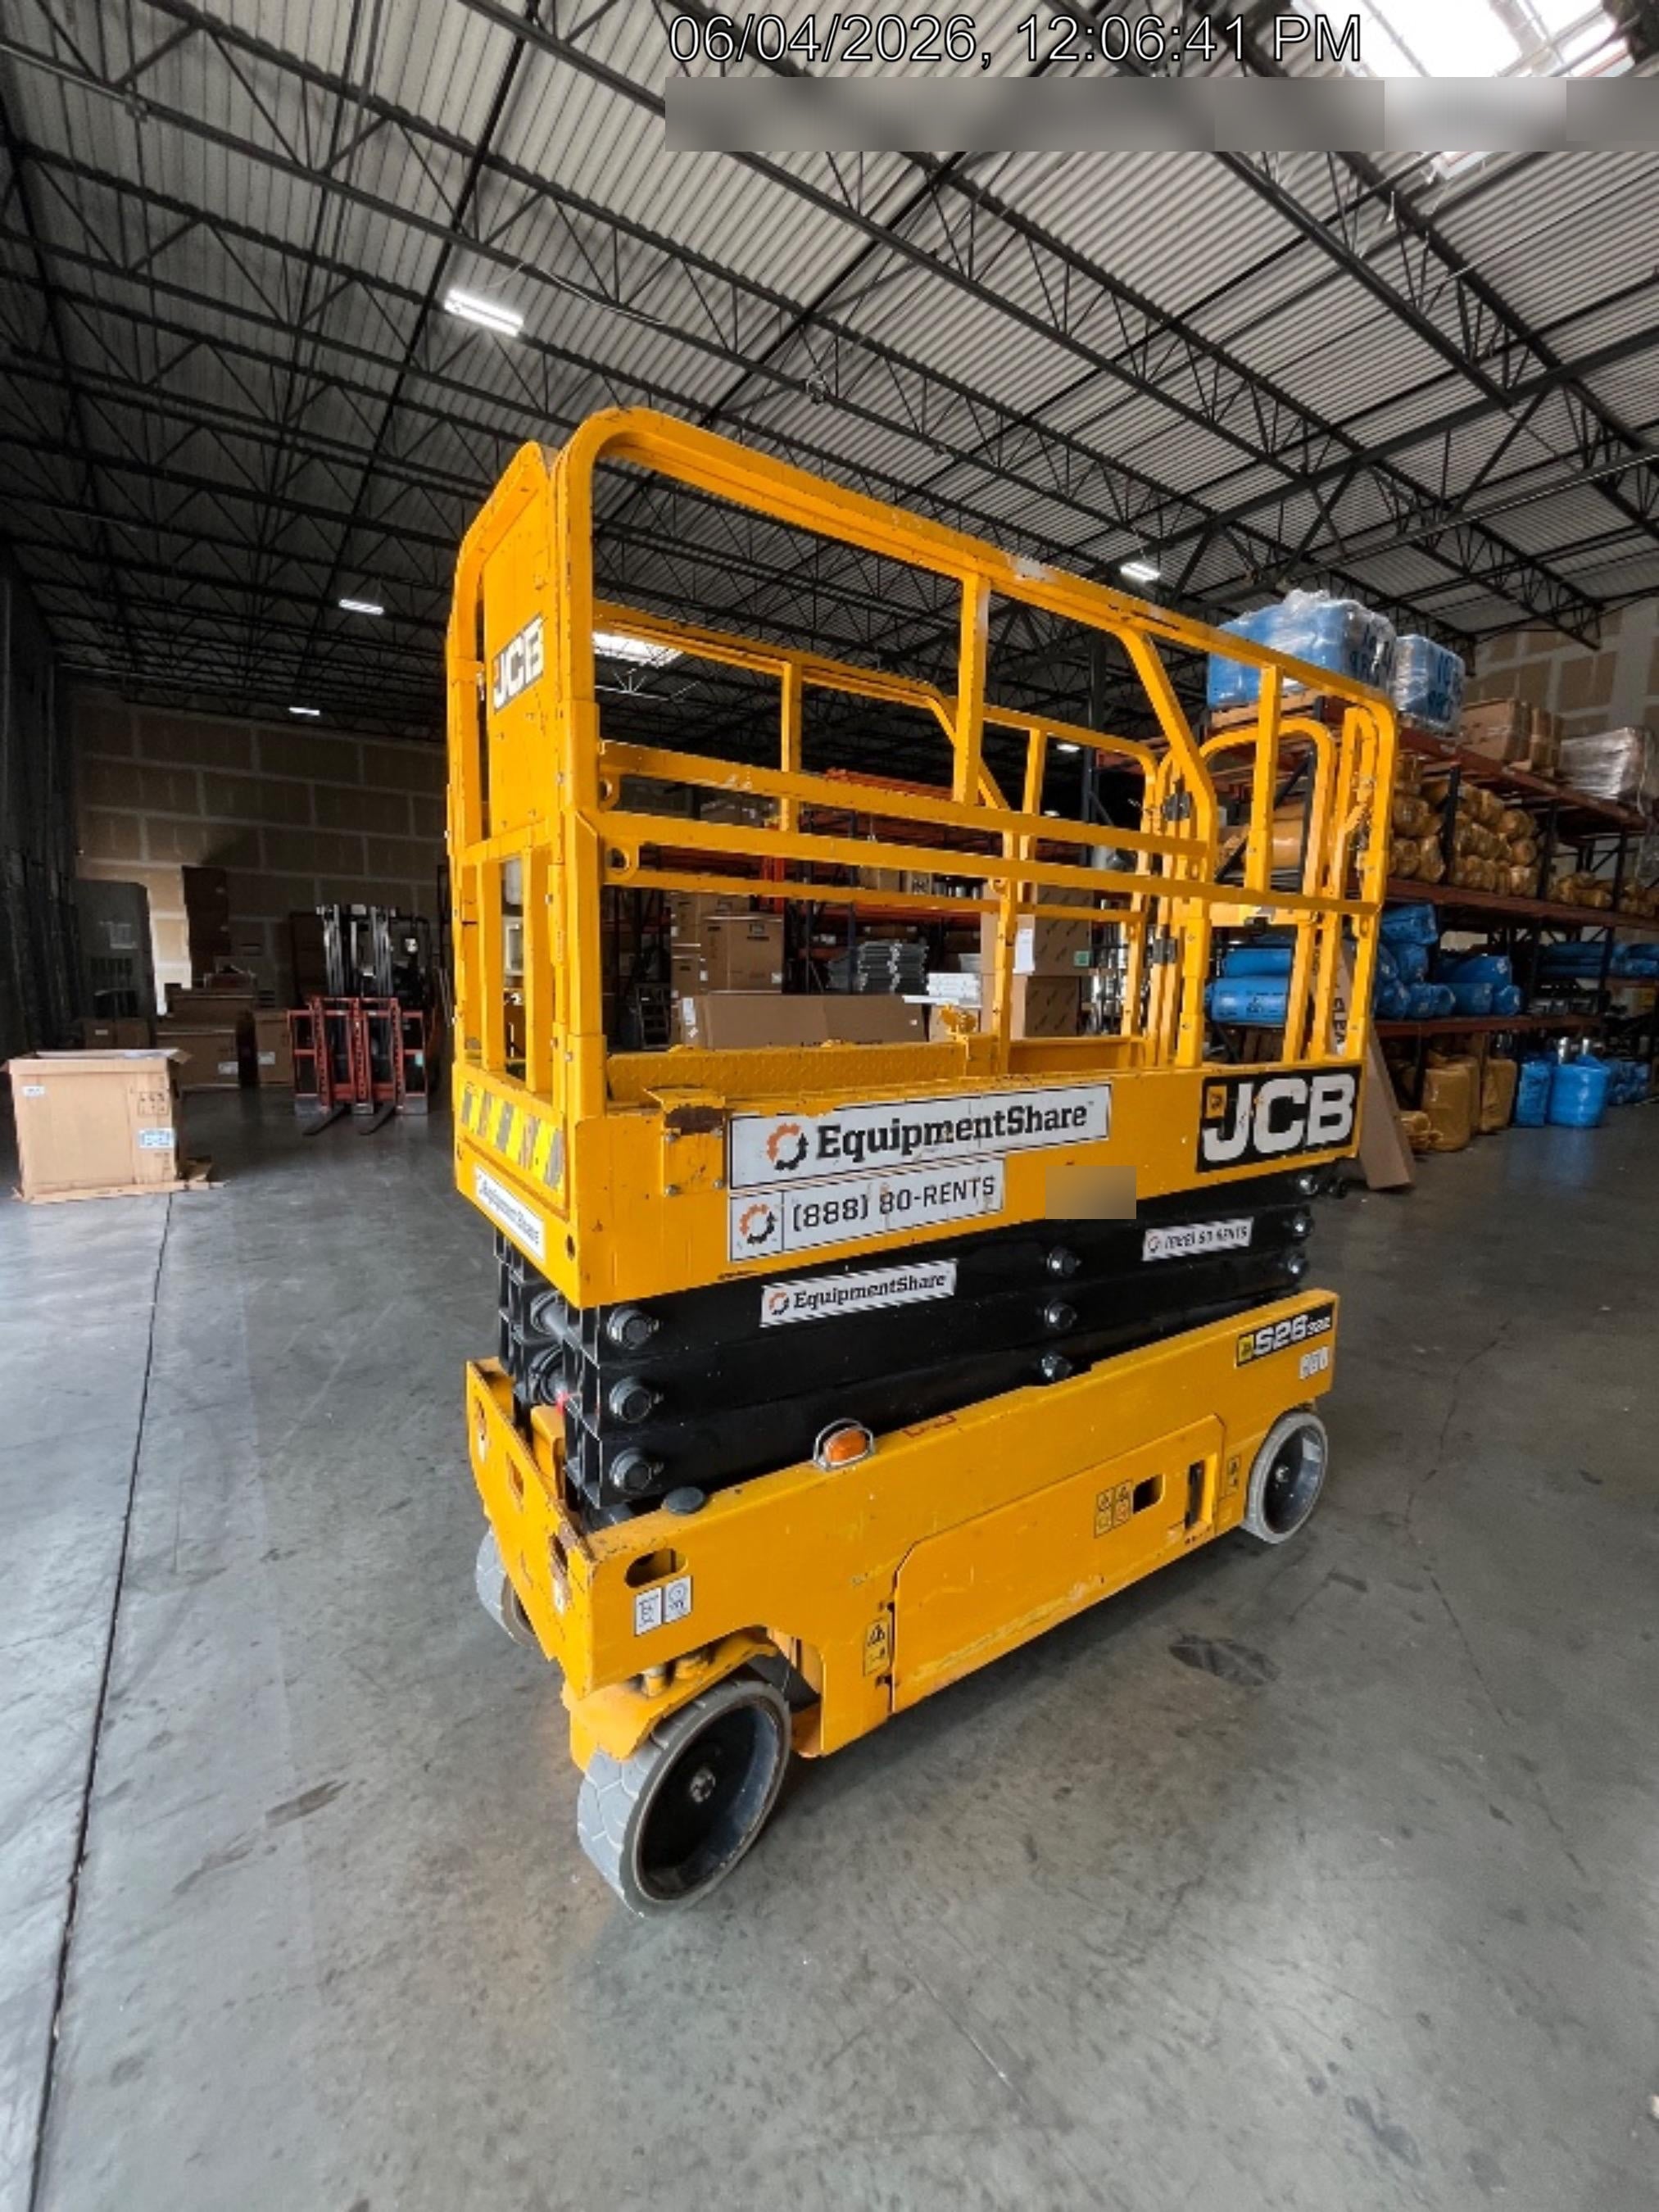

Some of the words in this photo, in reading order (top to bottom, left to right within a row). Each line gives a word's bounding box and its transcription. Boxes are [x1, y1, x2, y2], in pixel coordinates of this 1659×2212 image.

[493, 616, 545, 709] JCB
[816, 1104, 1088, 1163] EquipmentShare
[1202, 1074, 1355, 1163] JCB
[792, 1192, 869, 1232] (888)
[879, 1174, 995, 1214] 80-RENTS
[794, 1275, 947, 1310] EquipmentShare
